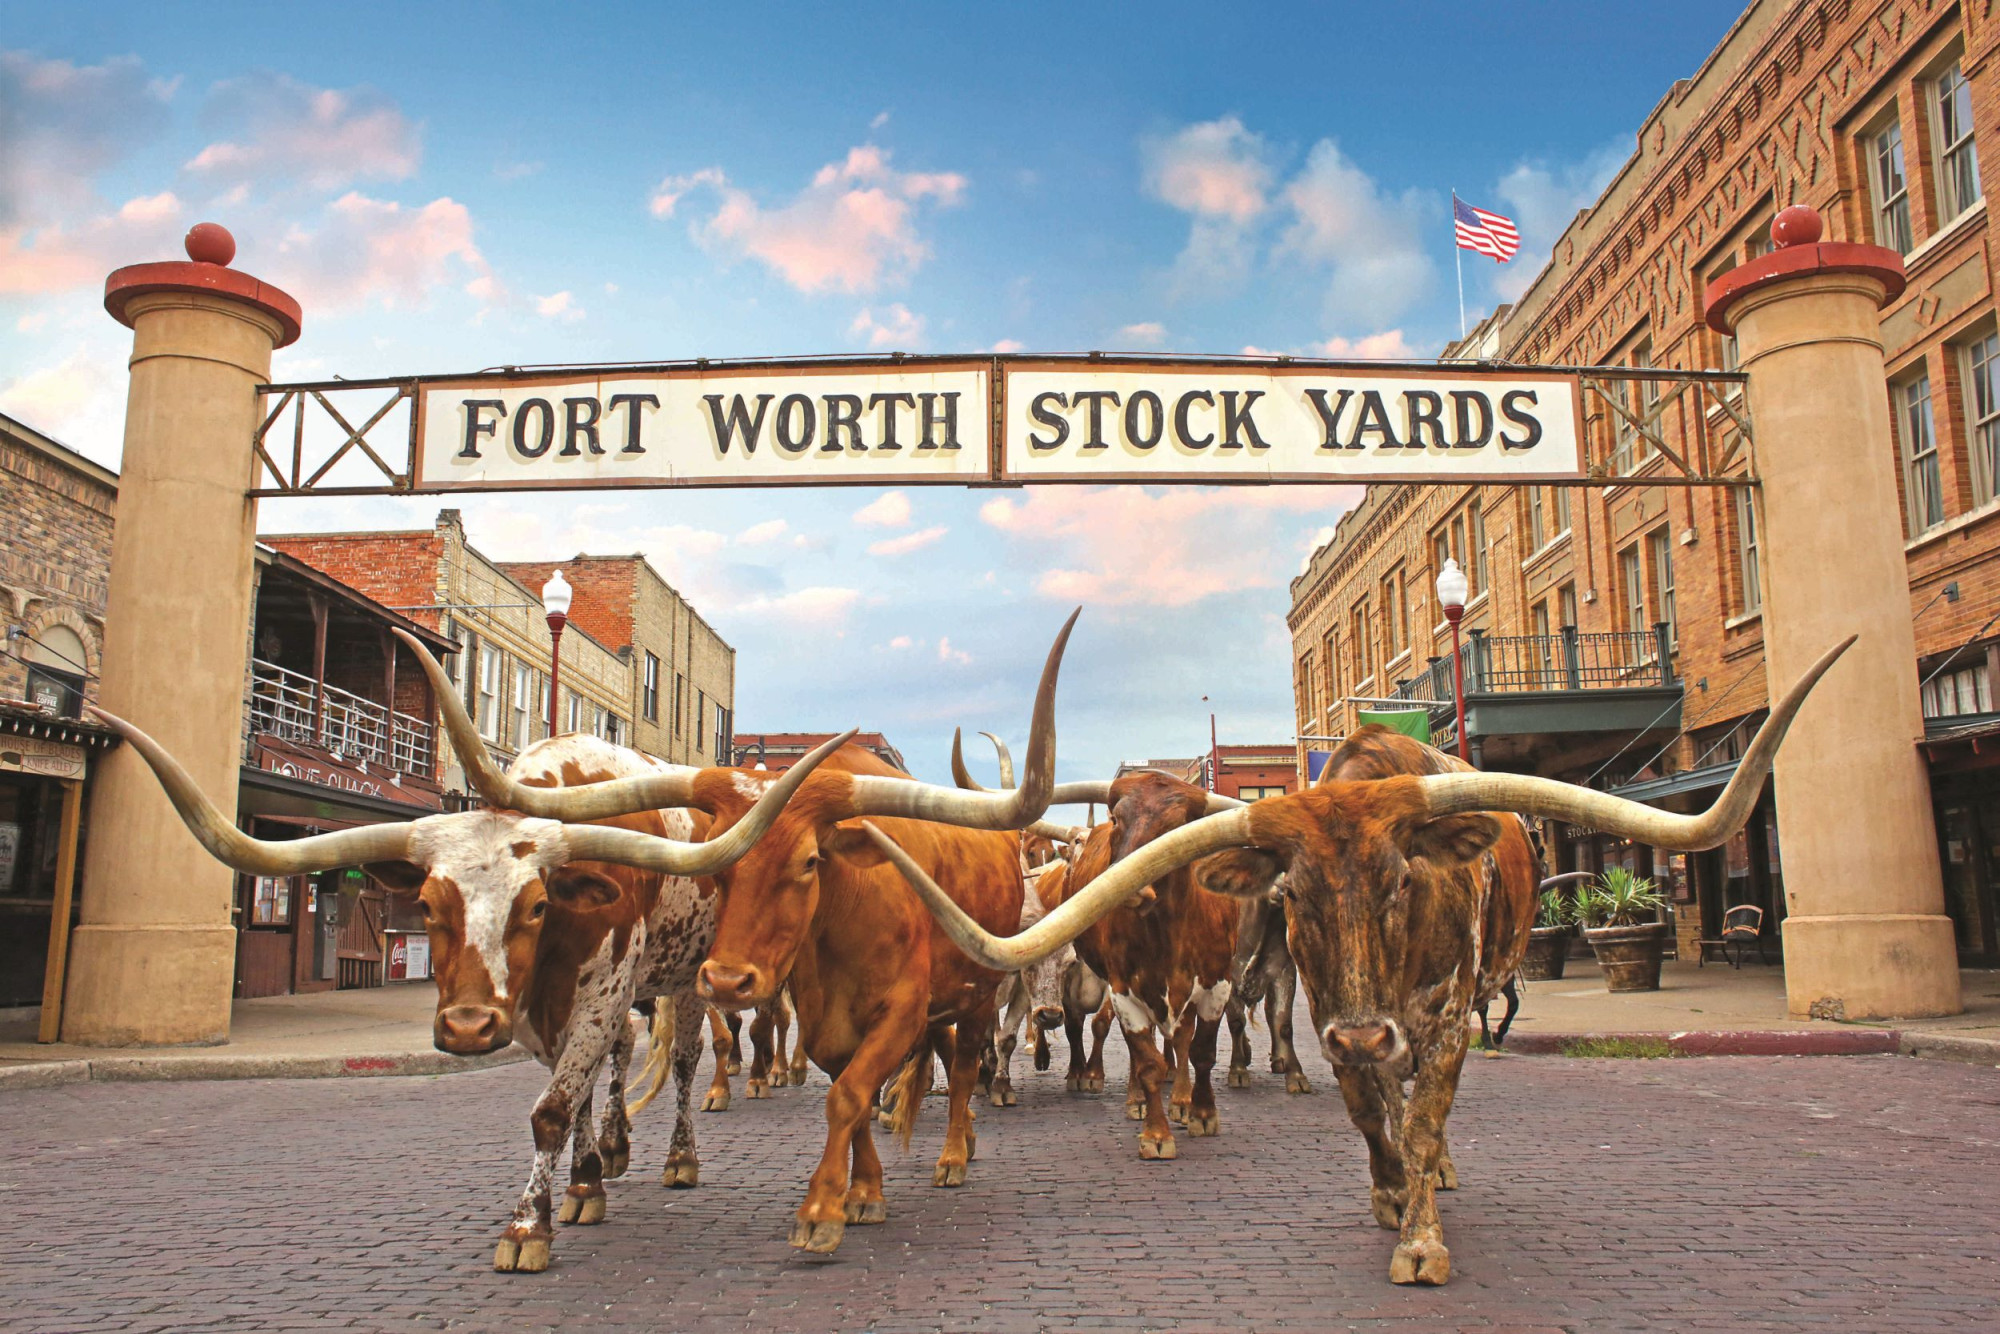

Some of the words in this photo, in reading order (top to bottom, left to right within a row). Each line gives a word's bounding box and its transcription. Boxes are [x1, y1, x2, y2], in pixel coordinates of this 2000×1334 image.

[458, 393, 660, 458] FORT
[702, 391, 962, 454] WORTH
[1030, 389, 1271, 450] STOCK
[1304, 388, 1543, 451] YARDS
[1, 736, 31, 752] HOUSE
[34, 741, 45, 754] OF
[48, 743, 82, 760] BLADES
[27, 757, 49, 769] KNIFE
[51, 759, 73, 773] ALLEY
